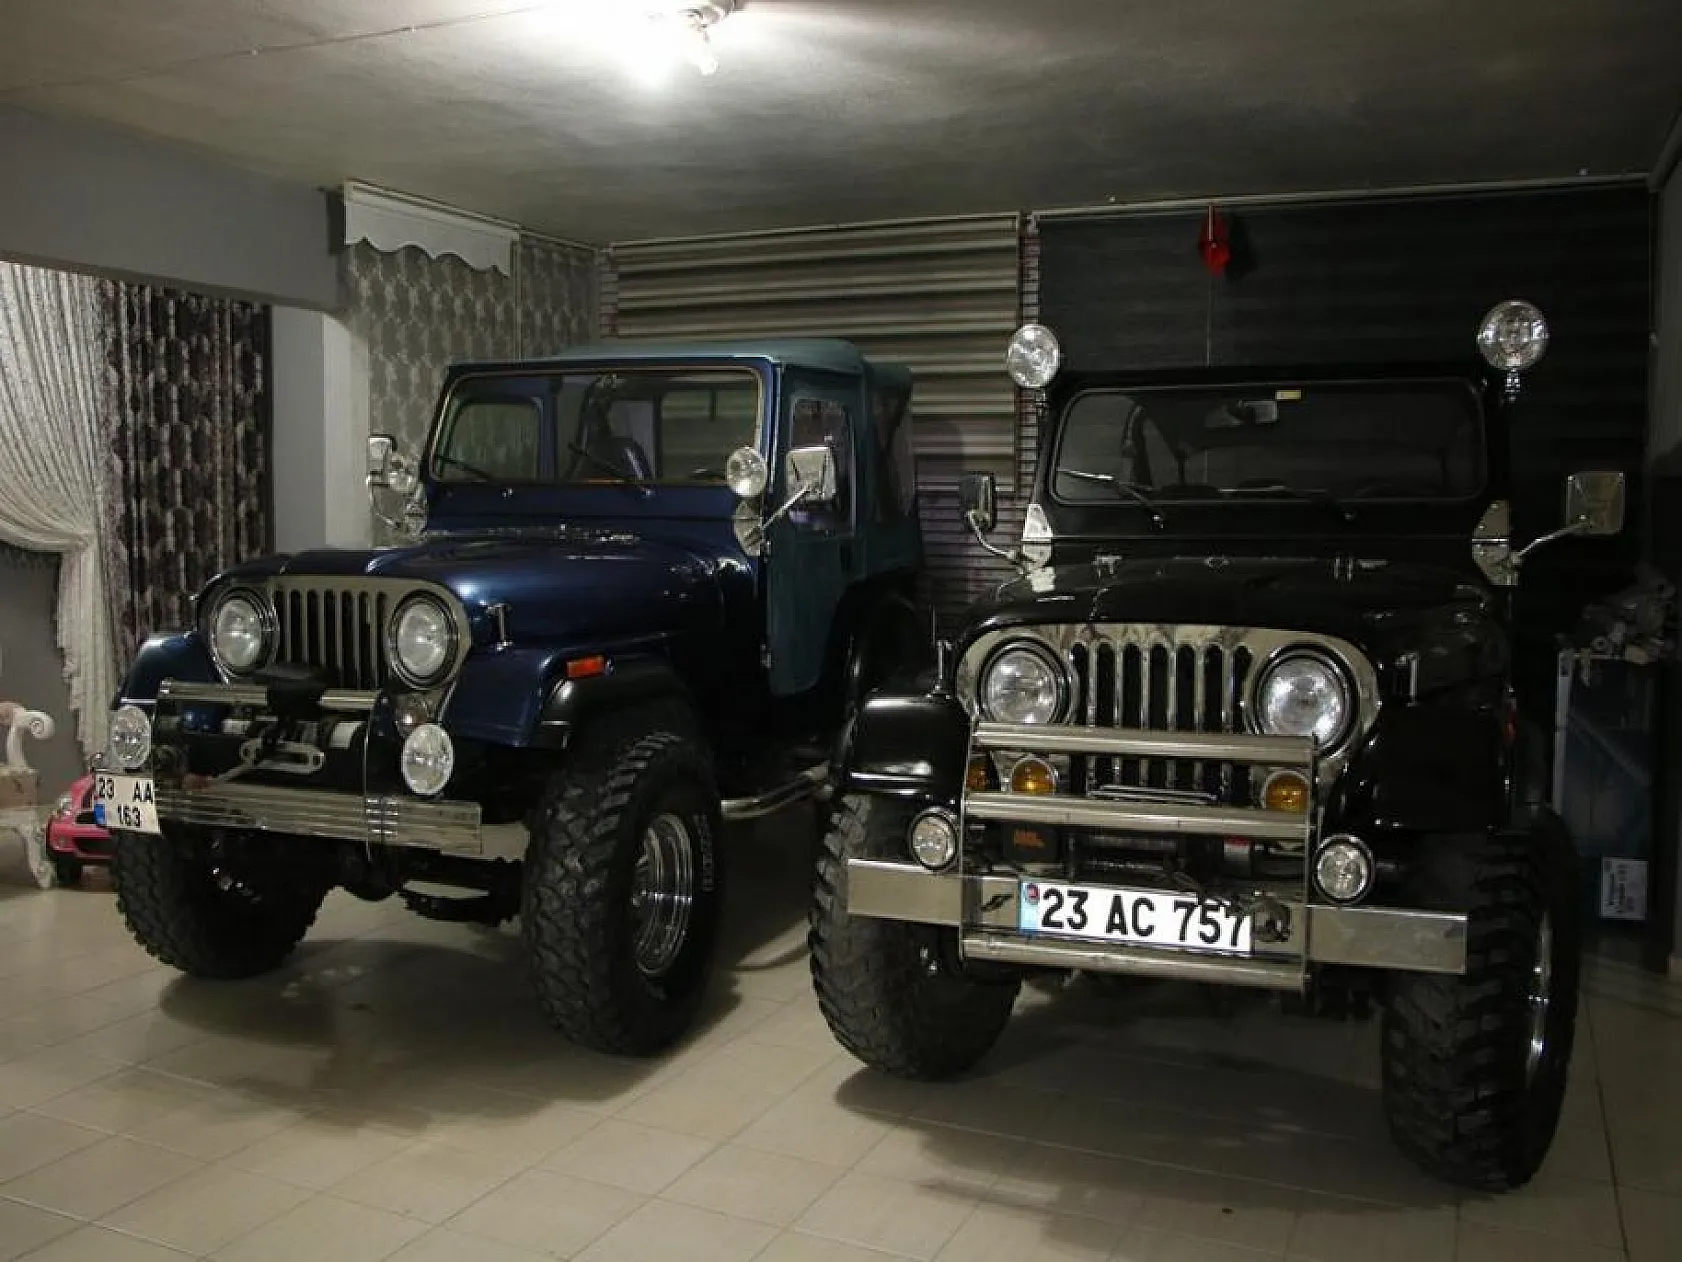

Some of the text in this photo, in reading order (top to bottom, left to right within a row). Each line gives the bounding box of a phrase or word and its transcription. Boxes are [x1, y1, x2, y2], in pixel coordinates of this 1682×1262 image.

[98, 777, 154, 805] 23 AA
[117, 803, 141, 829] 163
[1041, 888, 1244, 947] 23 AC 757
